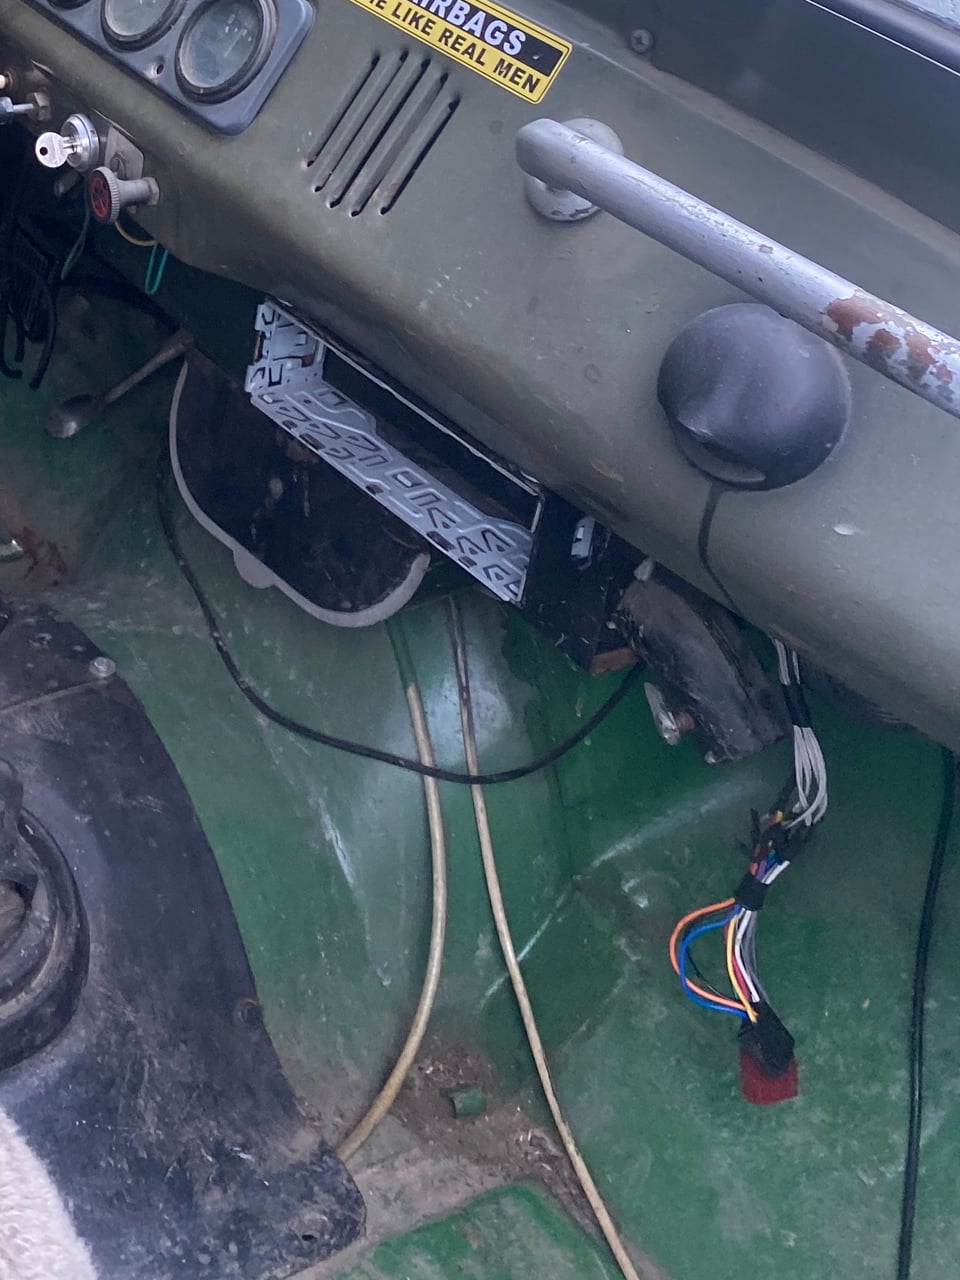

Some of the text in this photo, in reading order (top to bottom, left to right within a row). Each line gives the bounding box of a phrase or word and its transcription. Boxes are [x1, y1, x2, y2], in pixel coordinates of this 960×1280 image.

[391, 1, 437, 37] LIKE
[437, 27, 486, 67] REAL
[493, 58, 540, 94] MEN
